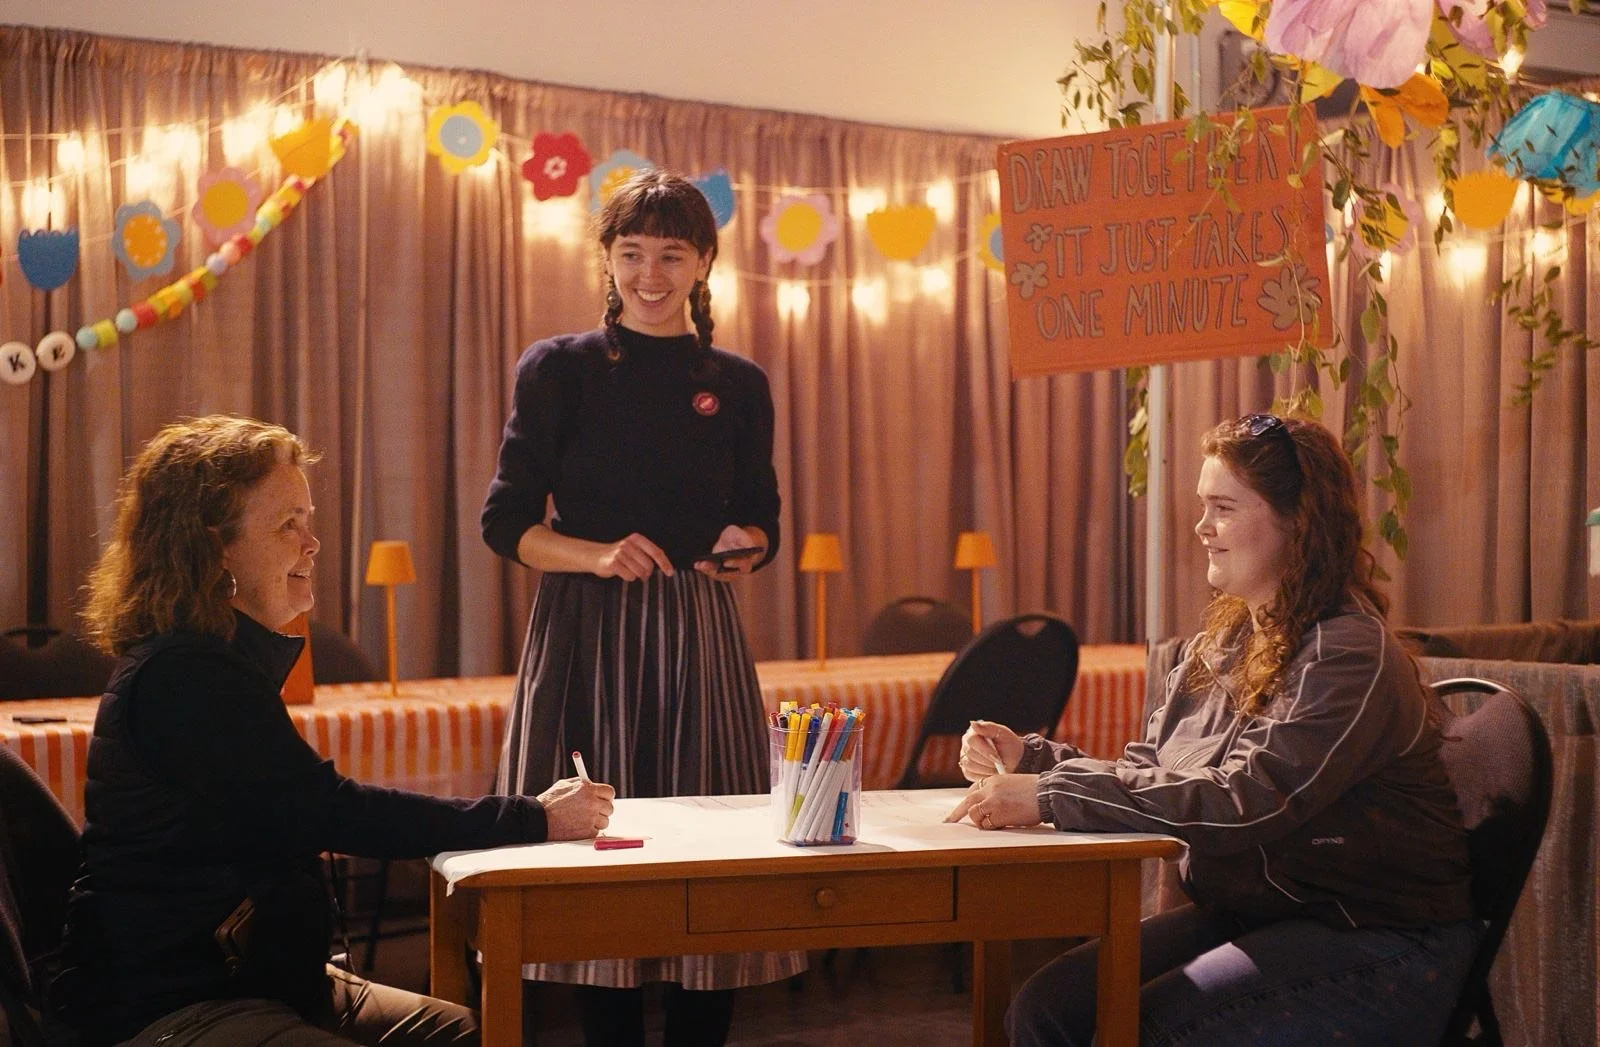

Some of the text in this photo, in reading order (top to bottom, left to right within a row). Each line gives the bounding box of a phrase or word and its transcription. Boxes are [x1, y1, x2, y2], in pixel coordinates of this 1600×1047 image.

[1010, 144, 1093, 214] DRAW
[1054, 205, 1291, 278] IT JUST TAKES
[1036, 273, 1249, 340] ONE MINUTE
